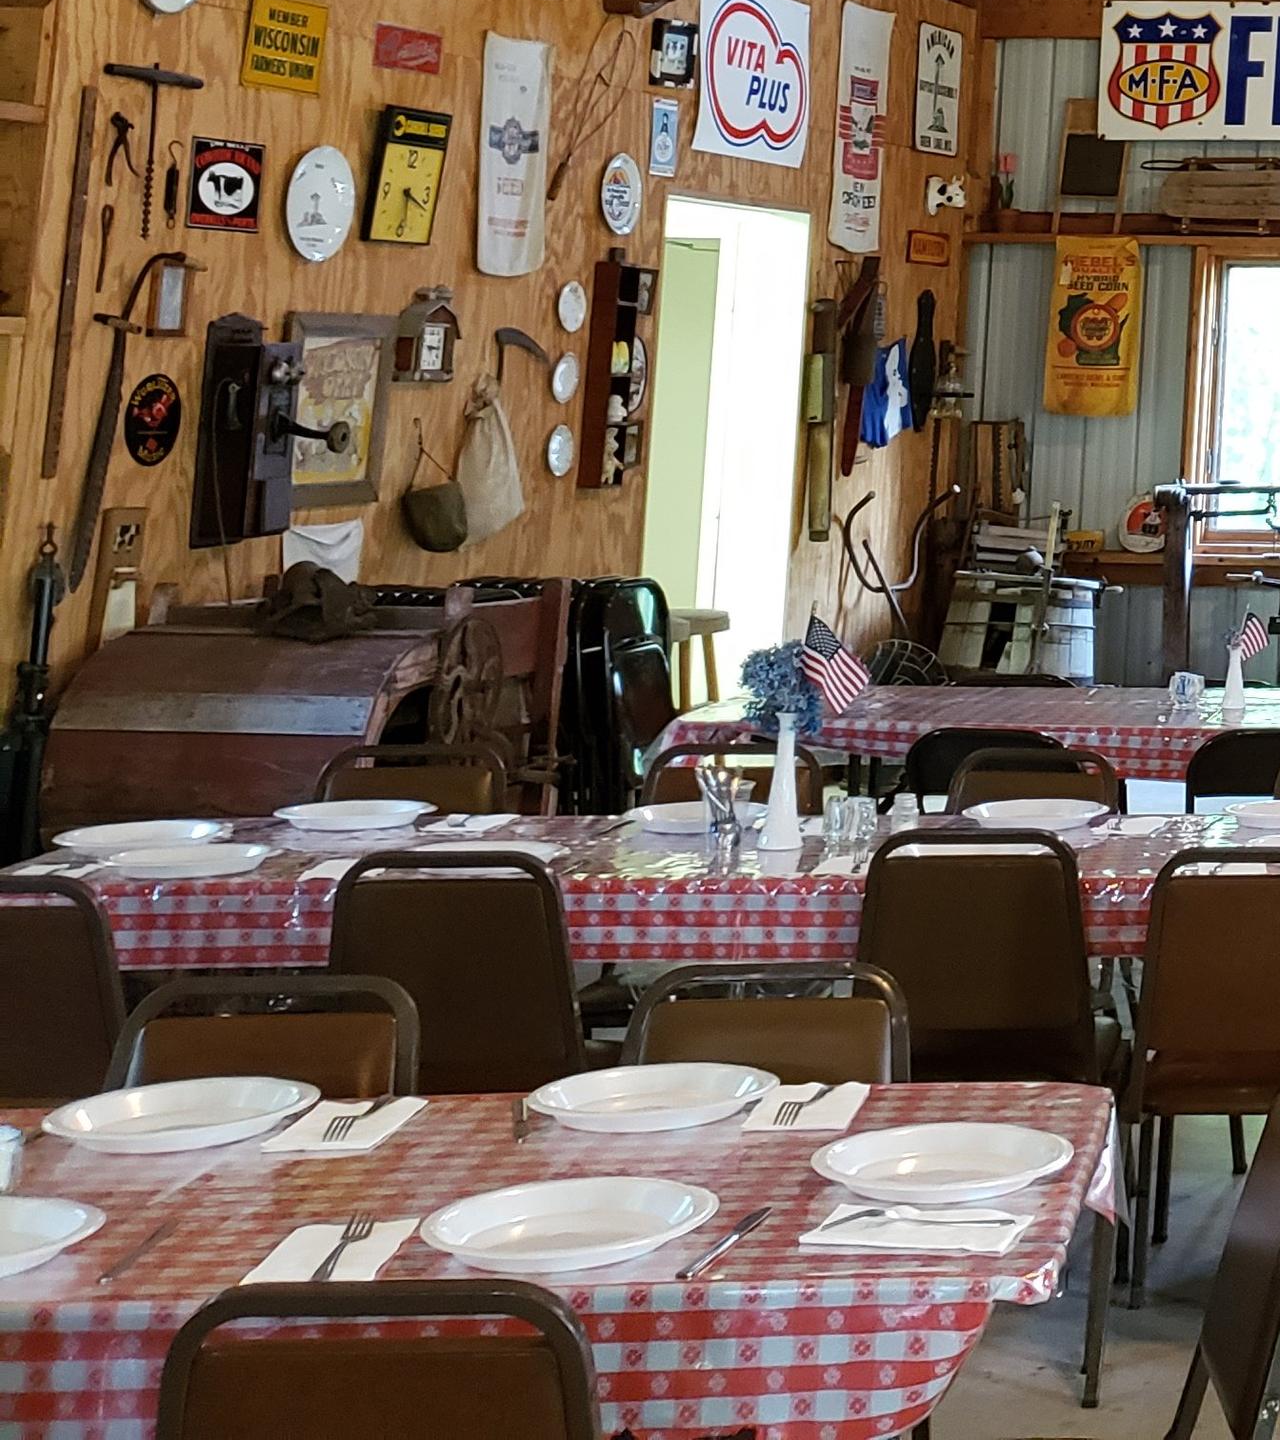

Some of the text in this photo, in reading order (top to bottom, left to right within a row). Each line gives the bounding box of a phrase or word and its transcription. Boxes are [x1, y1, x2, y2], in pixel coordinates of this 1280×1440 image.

[268, 7, 309, 28] MEMBER
[253, 24, 320, 58] WISCONSIN
[727, 36, 766, 74] VITA
[253, 55, 288, 77] FARMERS
[745, 75, 790, 114] PLUS
[382, 182, 392, 201] 9
[422, 186, 432, 205] 3
[1067, 281, 1129, 291] SEED CORN
